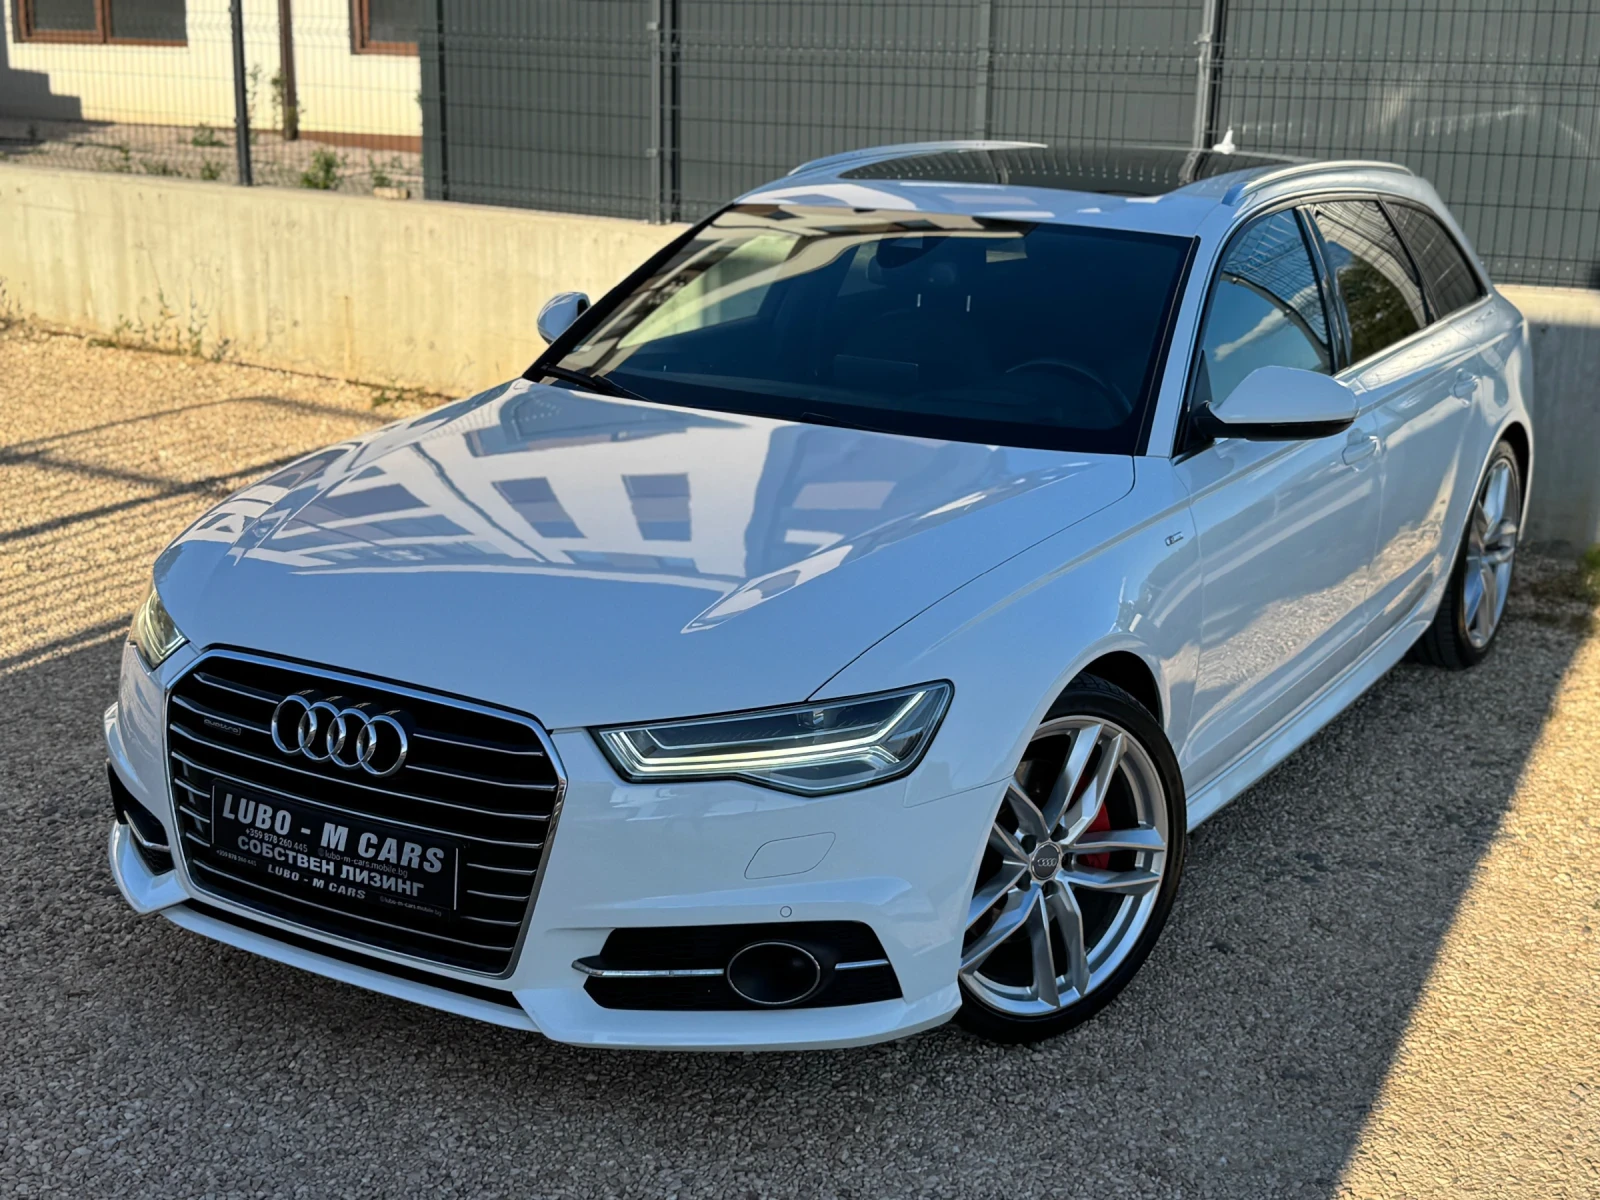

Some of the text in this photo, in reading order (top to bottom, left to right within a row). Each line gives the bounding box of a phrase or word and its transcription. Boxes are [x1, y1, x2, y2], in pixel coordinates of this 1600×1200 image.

[222, 793, 445, 874] LUBO - M CARS
[245, 828, 308, 853] +359 878 260 445
[237, 835, 424, 897] СОБСТВЕН ЛИЗИНГ
[267, 863, 300, 881] LUBO
[312, 878, 325, 889] M
[328, 882, 366, 900] CARS
